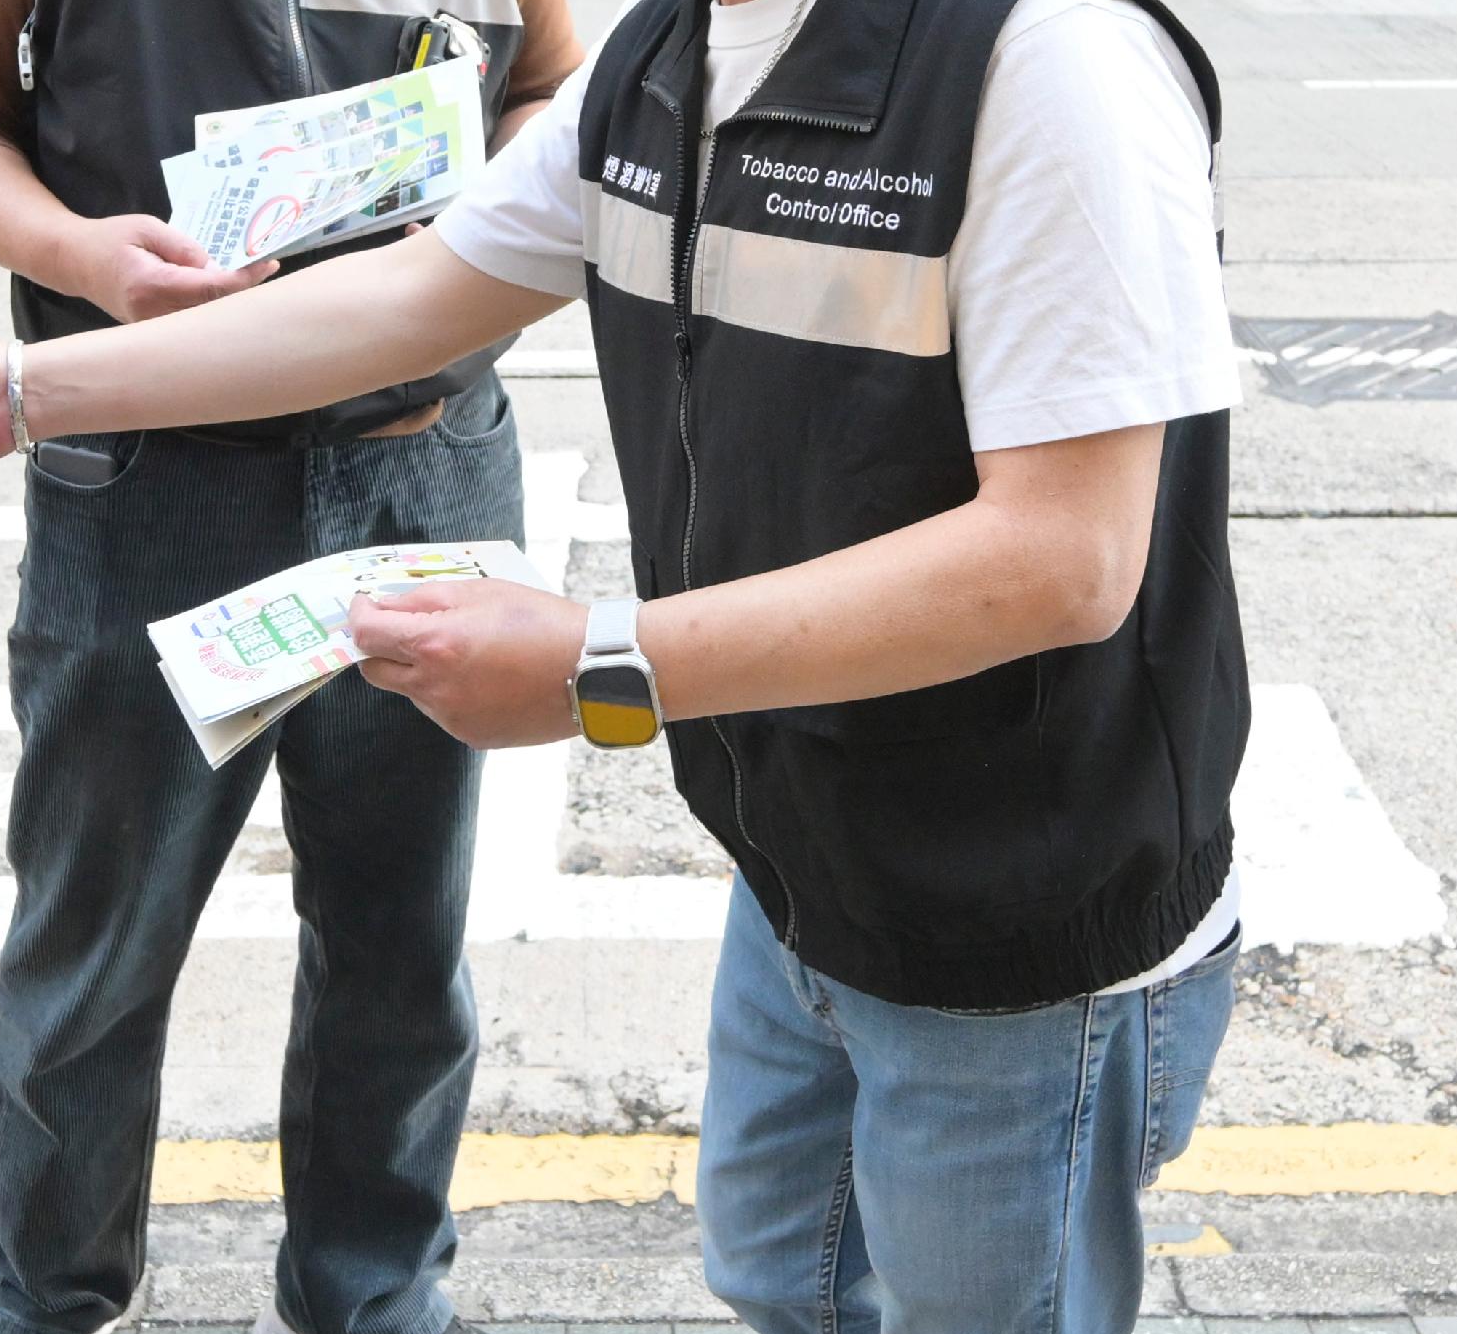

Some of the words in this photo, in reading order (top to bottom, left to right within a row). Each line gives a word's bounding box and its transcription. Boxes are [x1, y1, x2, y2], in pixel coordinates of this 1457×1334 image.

[741, 154, 819, 184] Tobacco
[824, 169, 862, 191] and
[862, 168, 934, 198] Alcohol
[765, 193, 837, 222] Control
[838, 203, 901, 231] Office
